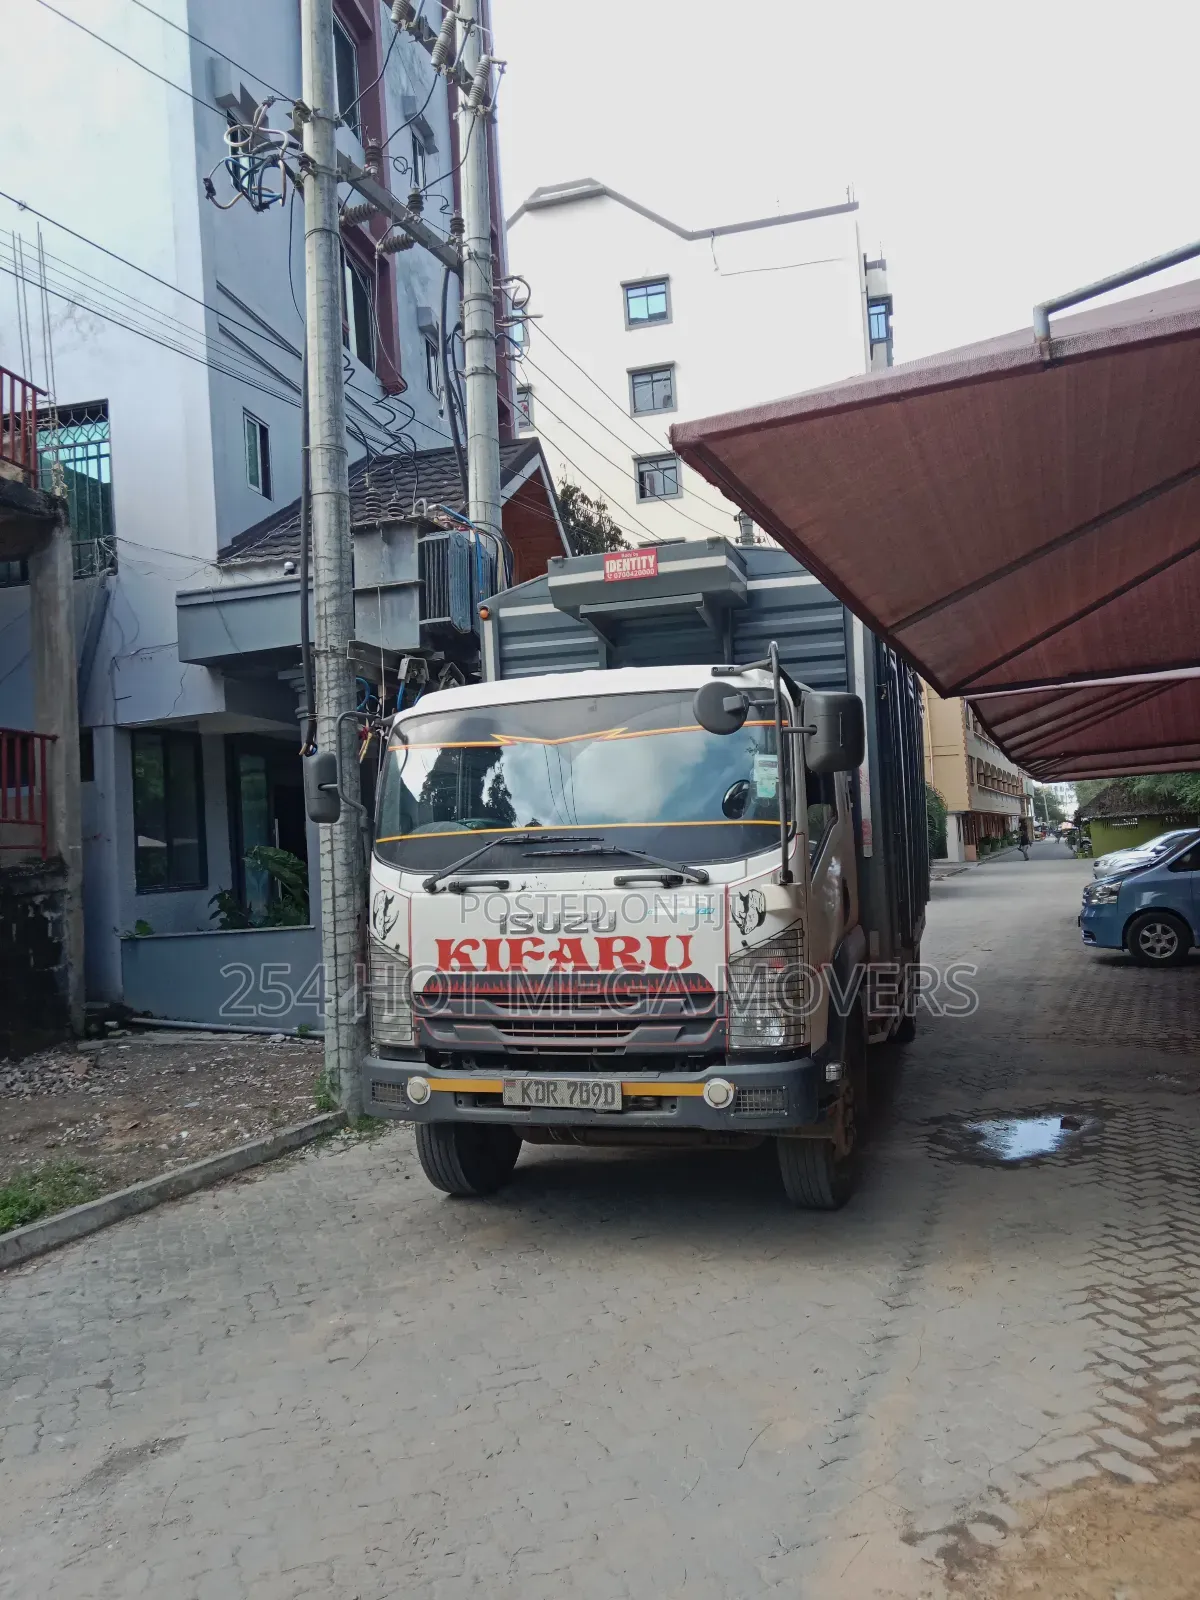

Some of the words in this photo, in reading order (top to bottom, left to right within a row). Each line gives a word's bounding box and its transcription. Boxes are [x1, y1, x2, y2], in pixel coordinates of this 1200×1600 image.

[605, 555, 656, 573] IDENTITY
[500, 909, 617, 935] ISUZU
[434, 934, 694, 973] KIFARU
[521, 1081, 559, 1104] KDR
